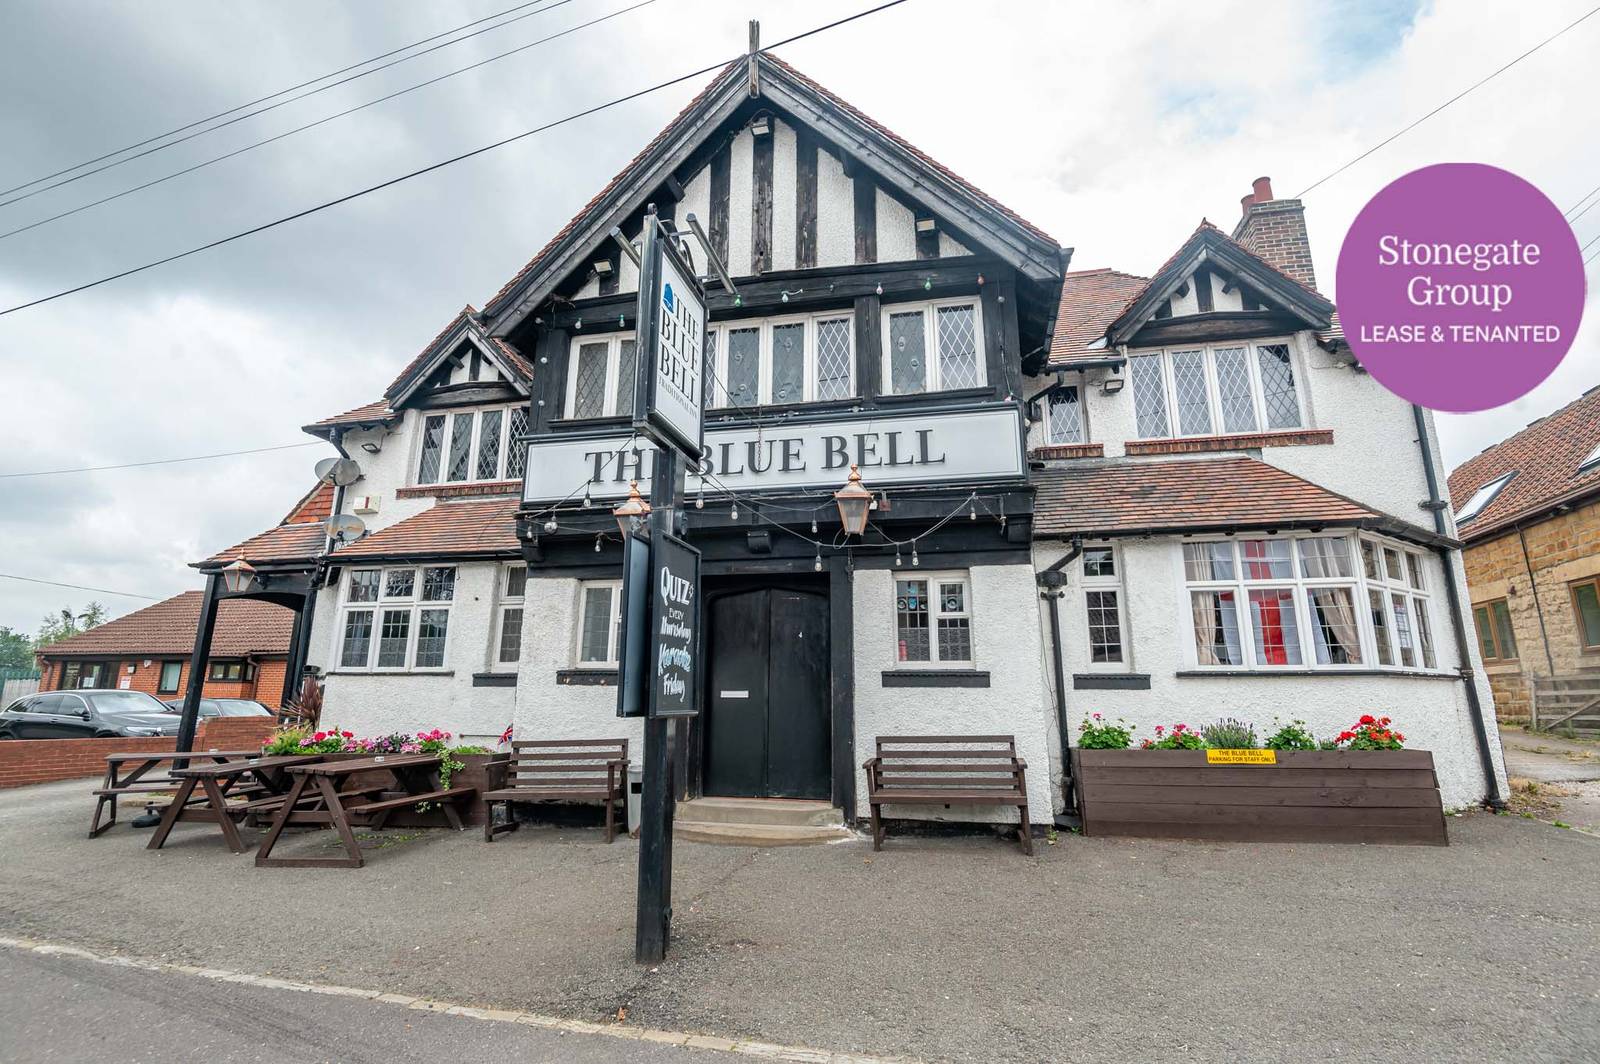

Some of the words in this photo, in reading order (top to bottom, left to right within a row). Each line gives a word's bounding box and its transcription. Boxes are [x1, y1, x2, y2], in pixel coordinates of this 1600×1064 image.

[660, 306, 699, 376] BLUE
[673, 292, 699, 346] THE
[658, 375, 690, 413] TRADITIONAL
[659, 341, 698, 408] BELL
[688, 438, 807, 477] BLUE
[820, 429, 947, 469] BELL
[663, 672, 686, 703] Friday
